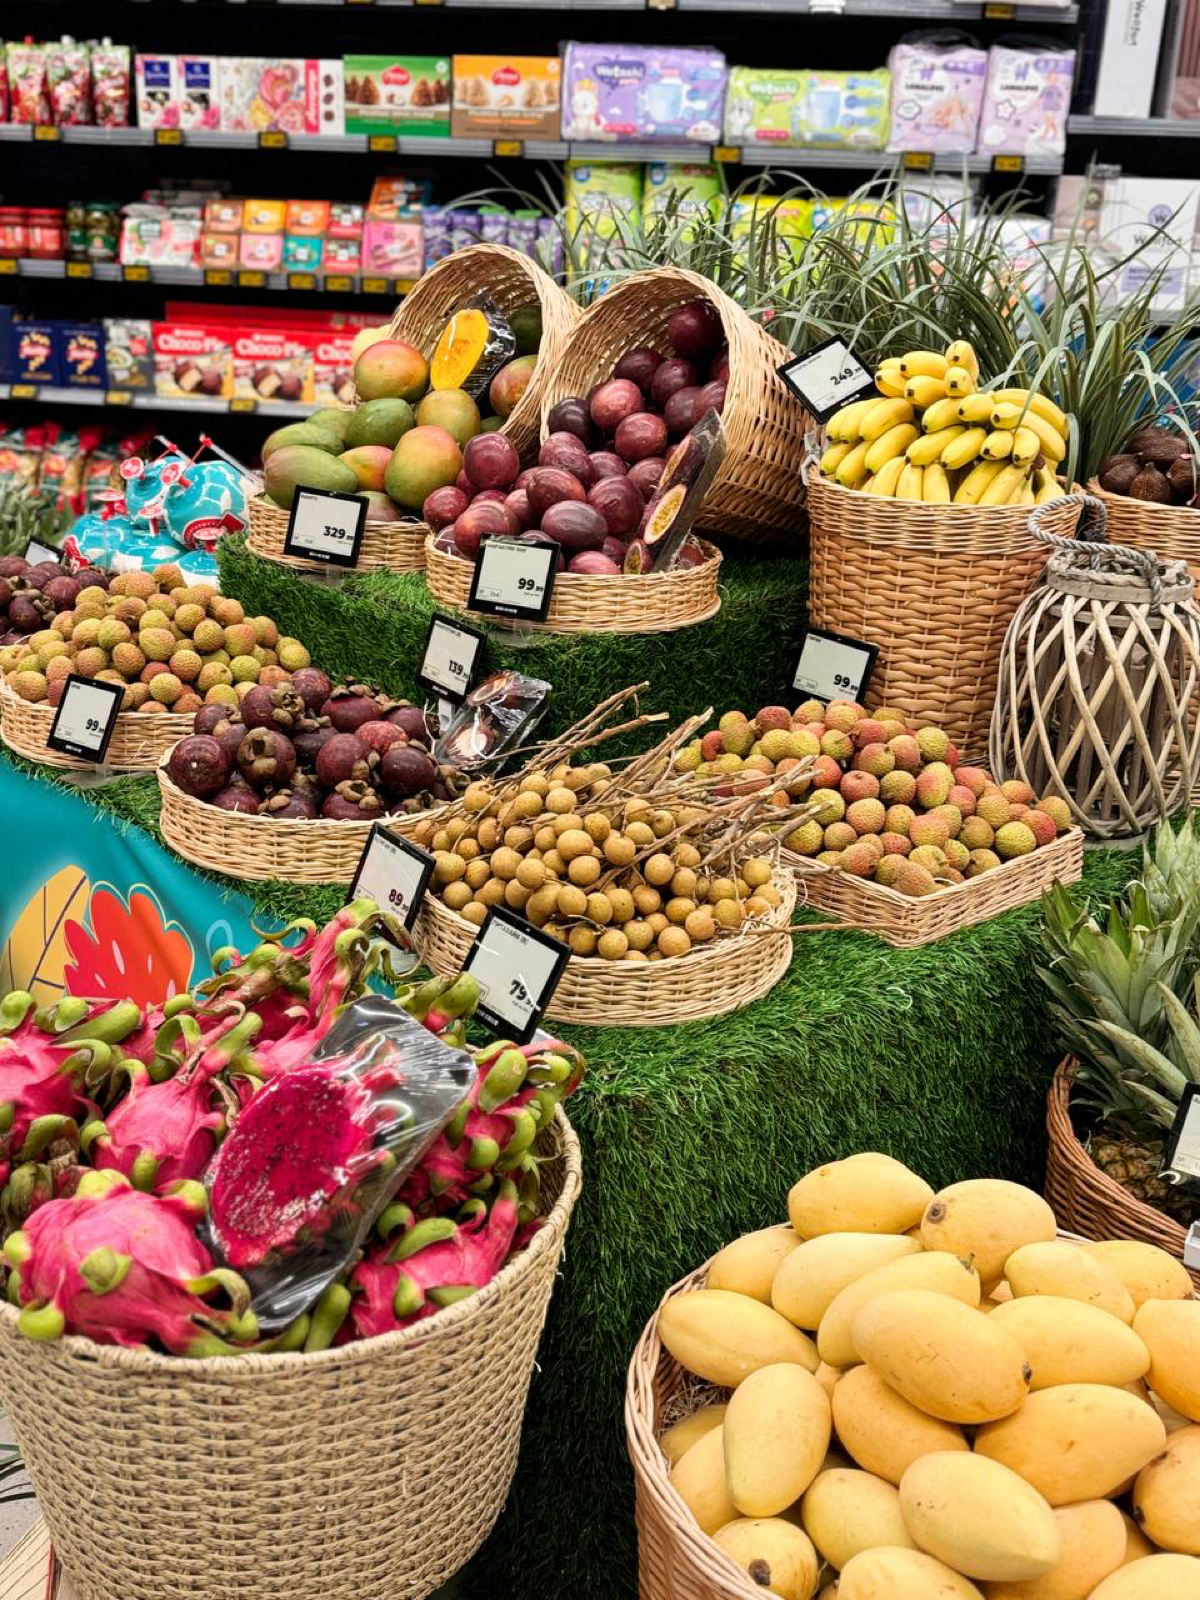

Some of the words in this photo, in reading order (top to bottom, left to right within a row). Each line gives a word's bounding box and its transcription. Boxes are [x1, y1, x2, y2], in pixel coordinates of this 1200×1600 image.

[158, 334, 201, 352] Choco
[204, 338, 228, 354] Pie
[236, 339, 281, 357] Choco
[284, 343, 307, 360] Pie
[317, 344, 352, 361] Choc
[830, 368, 853, 385] 249
[324, 525, 345, 539] 329
[517, 577, 535, 591] 99
[449, 660, 464, 676] 139
[833, 674, 850, 688] 99
[85, 718, 99, 731] 99
[389, 888, 404, 906] 89
[509, 979, 527, 1001] 79
